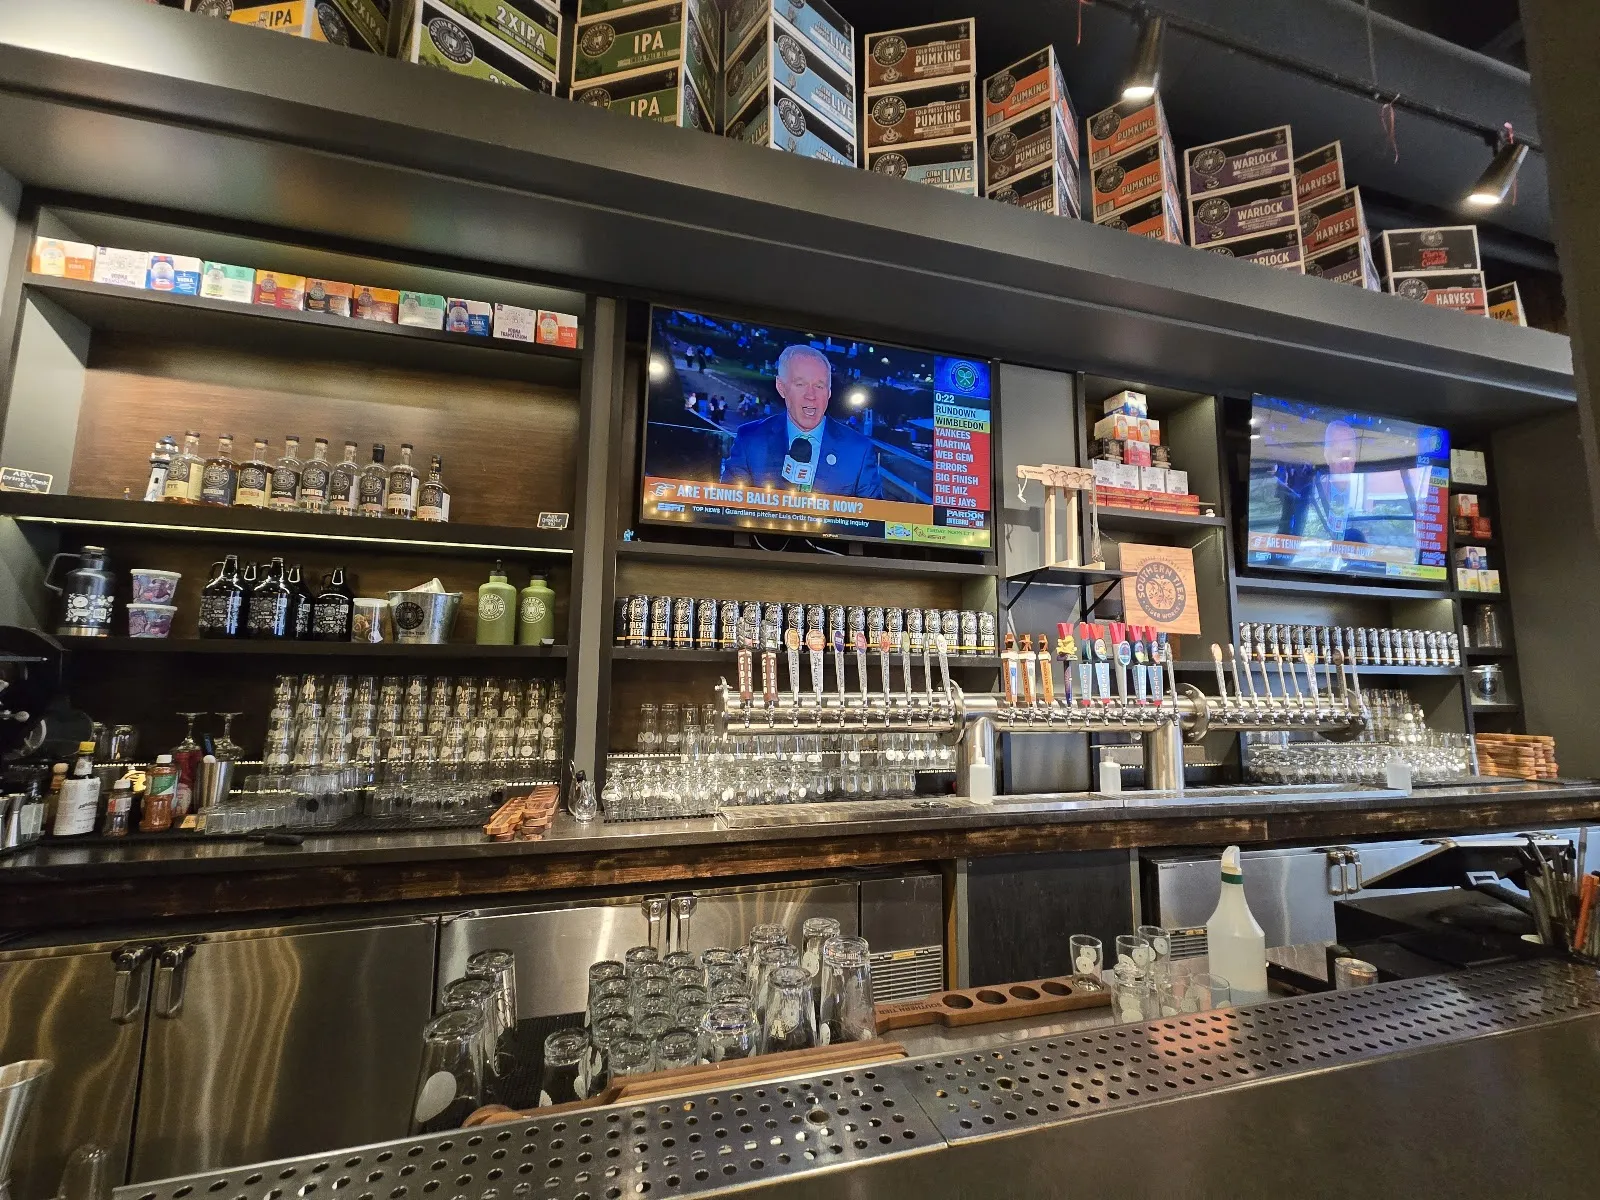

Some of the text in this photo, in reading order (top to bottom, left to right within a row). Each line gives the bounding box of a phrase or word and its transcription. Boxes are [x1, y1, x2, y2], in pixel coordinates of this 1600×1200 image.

[269, 9, 292, 27] IPA
[497, 5, 546, 51] 2XIPA
[430, 20, 465, 38] SOUTHERN
[582, 24, 608, 48] SOUTHERN
[634, 31, 664, 54] IPA
[830, 32, 851, 60] LIVE
[874, 37, 899, 58] SOUTHERN
[915, 50, 961, 66] PUMKING
[752, 58, 768, 81] LIVE
[1011, 80, 1047, 104] PUMKING
[631, 97, 660, 118] IPA
[832, 94, 853, 122] LIVE
[873, 97, 898, 117] SOUTHERN
[915, 110, 961, 128] PUMKING
[751, 121, 768, 144] LIVE
[1117, 118, 1154, 141] PUMKING
[1015, 142, 1051, 163] PUMKING
[1232, 150, 1278, 170] WARLOCK
[942, 167, 972, 182] LIVE
[1122, 172, 1158, 195] PUMKING
[1299, 170, 1338, 194] HARVEST
[1237, 201, 1283, 221] WARLOCK
[1315, 217, 1355, 241] HARVEST
[1436, 292, 1475, 305] HARVEST
[935, 392, 955, 404] 0:22
[935, 405, 976, 418] RUNDOWN
[935, 415, 984, 431] WIMBLEDON
[934, 427, 971, 440] YANKEES
[935, 438, 972, 451] MARTINA
[935, 450, 974, 463] WEB GEM
[935, 461, 968, 473] ERRORS
[935, 472, 979, 486] BIG FINISH
[677, 484, 864, 513] ARE TENNIS BALLS FLUFFIER NOW?
[934, 483, 968, 496] THE MIZ
[935, 495, 977, 508] BLUE JAYS
[704, 506, 720, 514] NEWS
[725, 508, 755, 517] Guardians
[757, 510, 778, 519] pitcher
[946, 509, 984, 520] PARDON
[1137, 563, 1173, 598] SOUTHERN
[1172, 576, 1184, 601] TIER
[1145, 604, 1180, 619] CIDER WORKS
[1100, 664, 1108, 697] VICTORY
[1152, 666, 1161, 699] VICTORY
[900, 1002, 942, 1012] SOUTHERN
